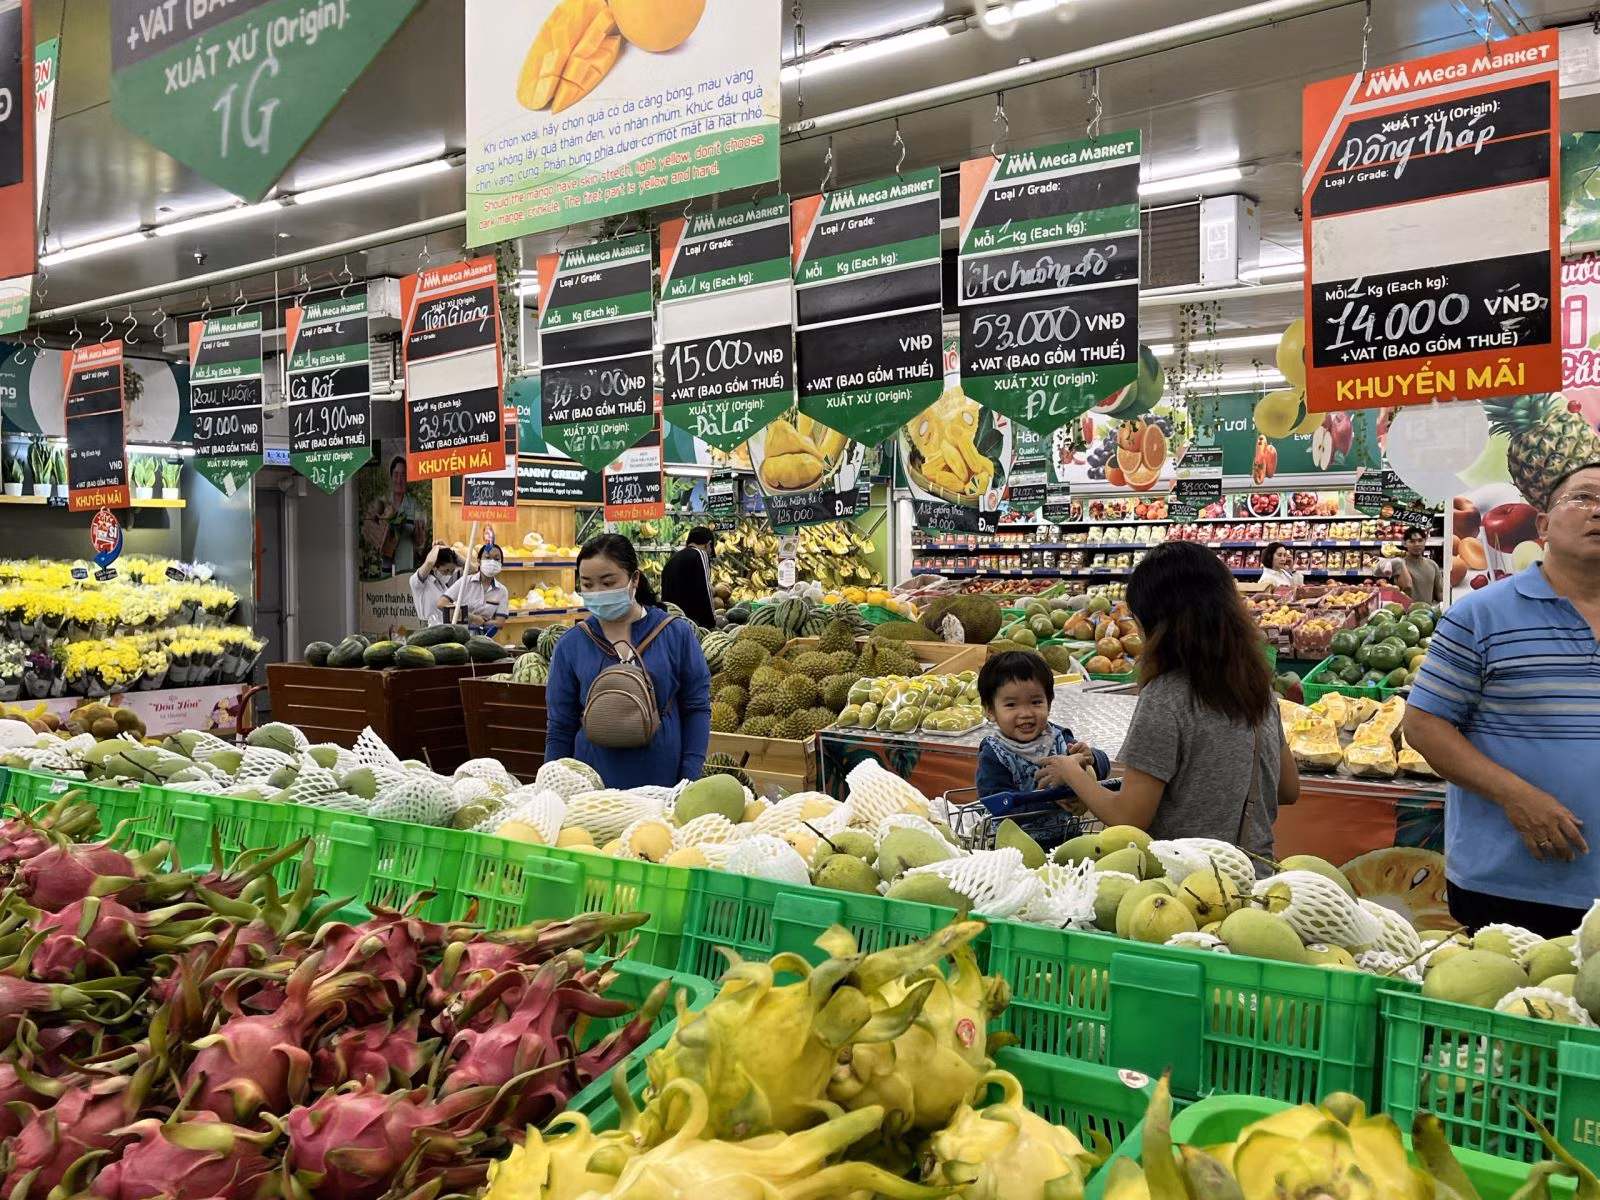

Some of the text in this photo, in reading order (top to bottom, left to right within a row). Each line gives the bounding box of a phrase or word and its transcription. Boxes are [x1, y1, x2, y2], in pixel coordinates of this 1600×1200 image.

[165, 37, 220, 94] XUẤT
[1415, 44, 1550, 86] Mega Market
[623, 101, 635, 114] da
[1382, 114, 1419, 134] XUẤT
[1449, 100, 1501, 120] (Origin):
[724, 134, 765, 153] choose
[1040, 141, 1134, 169] Mega Market
[672, 167, 690, 183] and
[1325, 168, 1389, 189] Loại Grade:
[857, 179, 934, 205] Mega Market
[994, 182, 1060, 201] Loại Grade:
[717, 205, 784, 228] Mega Market
[848, 217, 875, 230] Grade:
[1014, 231, 1026, 244] Kg
[1030, 225, 1062, 242] (Each
[1066, 221, 1087, 236] kg):
[587, 244, 645, 264] Mega Market
[837, 262, 848, 274] Kg
[851, 257, 878, 271] (Each
[881, 253, 898, 265] kg):
[700, 272, 753, 291] Kg (Each kg):
[1368, 285, 1382, 298] Kg
[1387, 279, 1423, 295] (Each
[1427, 275, 1449, 292] kg):
[1484, 292, 1540, 315] VNĐ
[1085, 313, 1125, 331] VNĐ
[900, 334, 932, 352] VNĐ
[1341, 326, 1518, 363] +VAT (BAO GỒM THUẾ)
[670, 340, 783, 384] 15.000 VNĐ
[971, 339, 1125, 371] +VAT (BAO GỒM THUẾ)
[620, 376, 645, 392] VNĐ
[671, 370, 784, 400] +VAT (BAO GỒM THUẾ)
[806, 359, 934, 391] +VAT (BAO GỒM THUẾ)
[994, 374, 1028, 390] XUẤT
[1053, 372, 1098, 386] (Origin):
[1336, 358, 1525, 401] KHUYẾN MÃI
[548, 397, 646, 422] +VAT (BAO GỒM THUẾ)
[689, 400, 712, 416] XUẤT
[732, 399, 764, 410] (Origin):
[826, 391, 853, 408] XUẤT
[875, 390, 912, 403] (Origin):
[295, 406, 347, 437] 11.900
[475, 412, 496, 424] VNĐ
[311, 438, 326, 448] (BAO
[437, 438, 452, 450] (BAO
[419, 451, 466, 474] KHUYẾN
